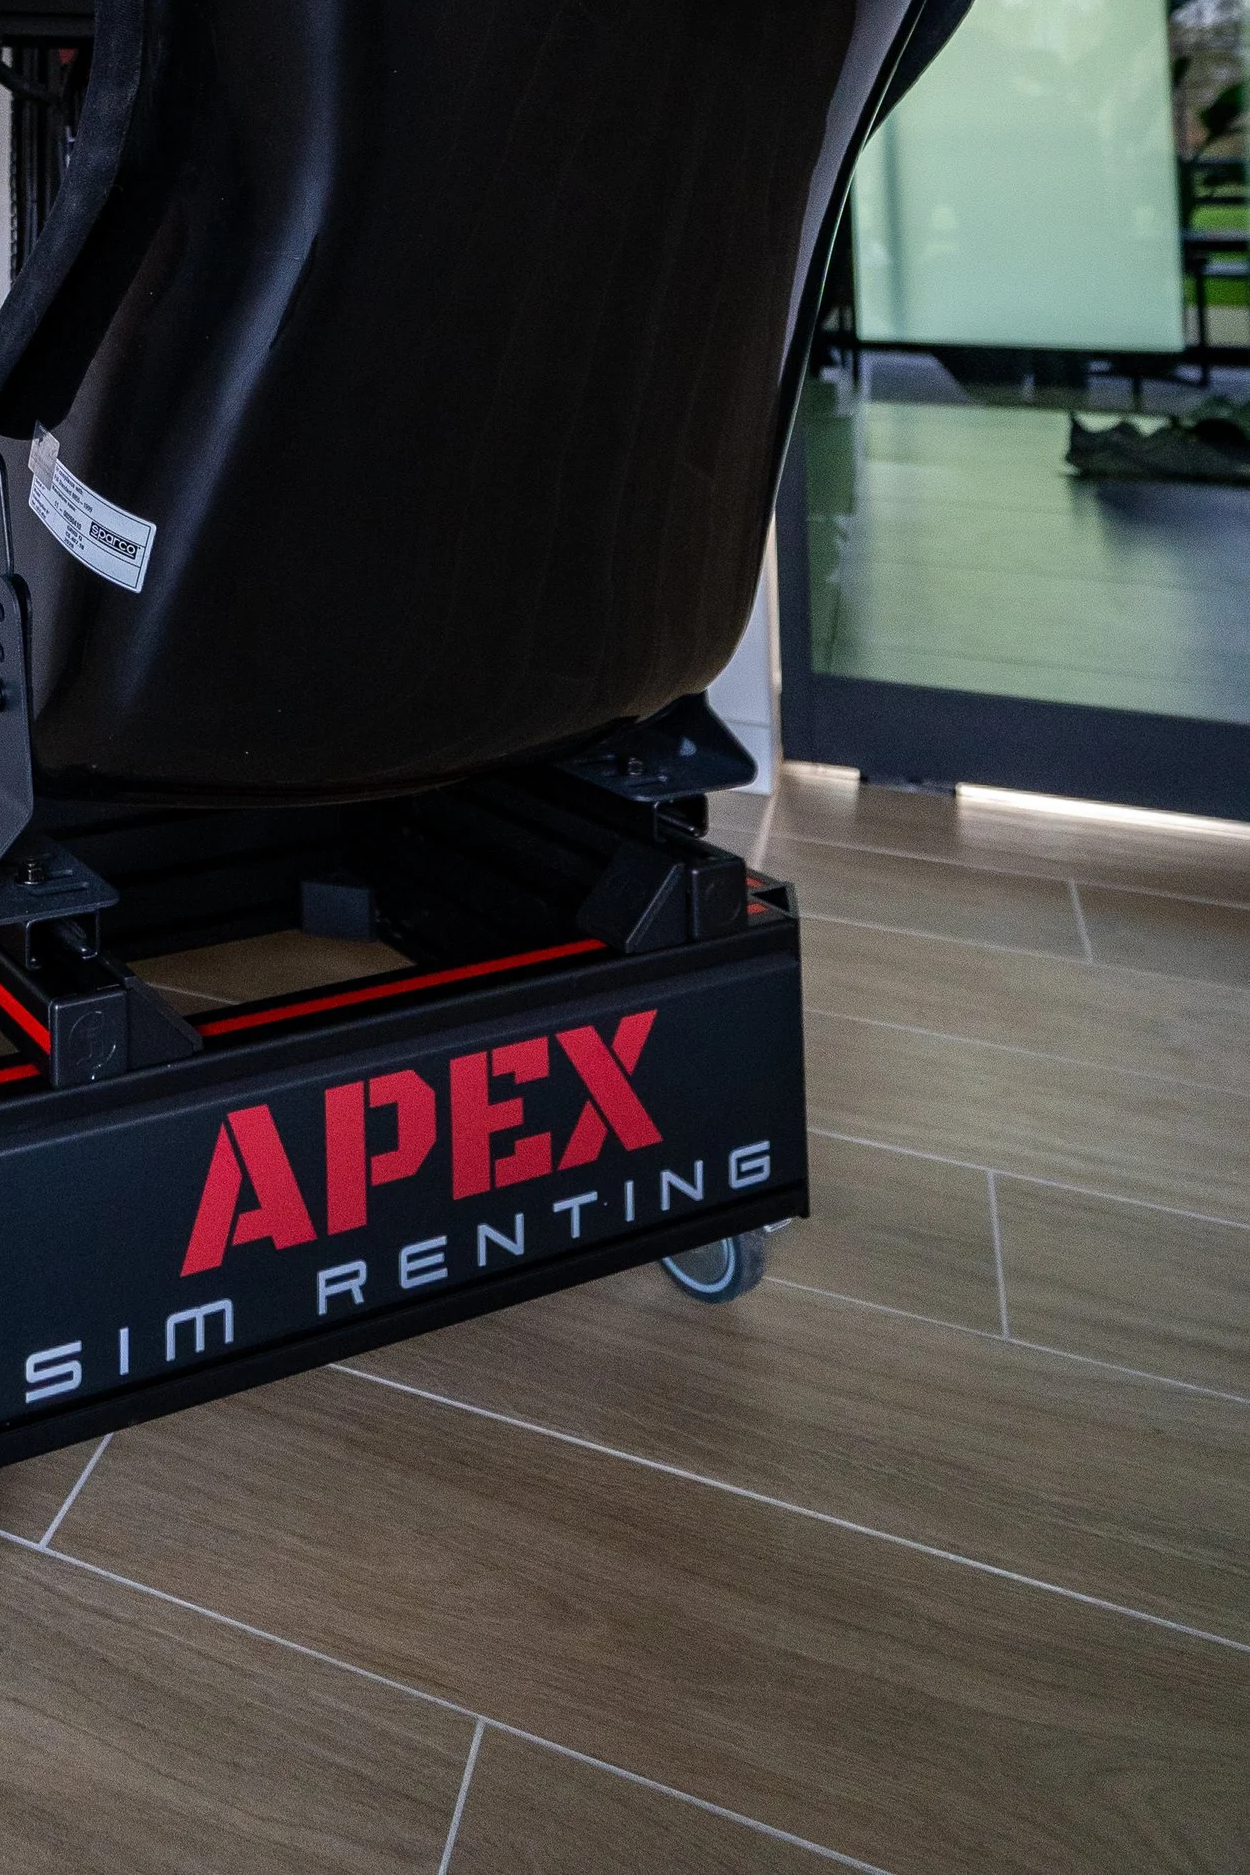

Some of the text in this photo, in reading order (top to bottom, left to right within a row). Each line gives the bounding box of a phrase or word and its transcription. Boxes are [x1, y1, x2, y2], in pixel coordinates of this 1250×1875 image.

[91, 523, 136, 555] sparco
[25, 1140, 772, 1404] SIM RENTING
[180, 1009, 663, 1277] APEX
